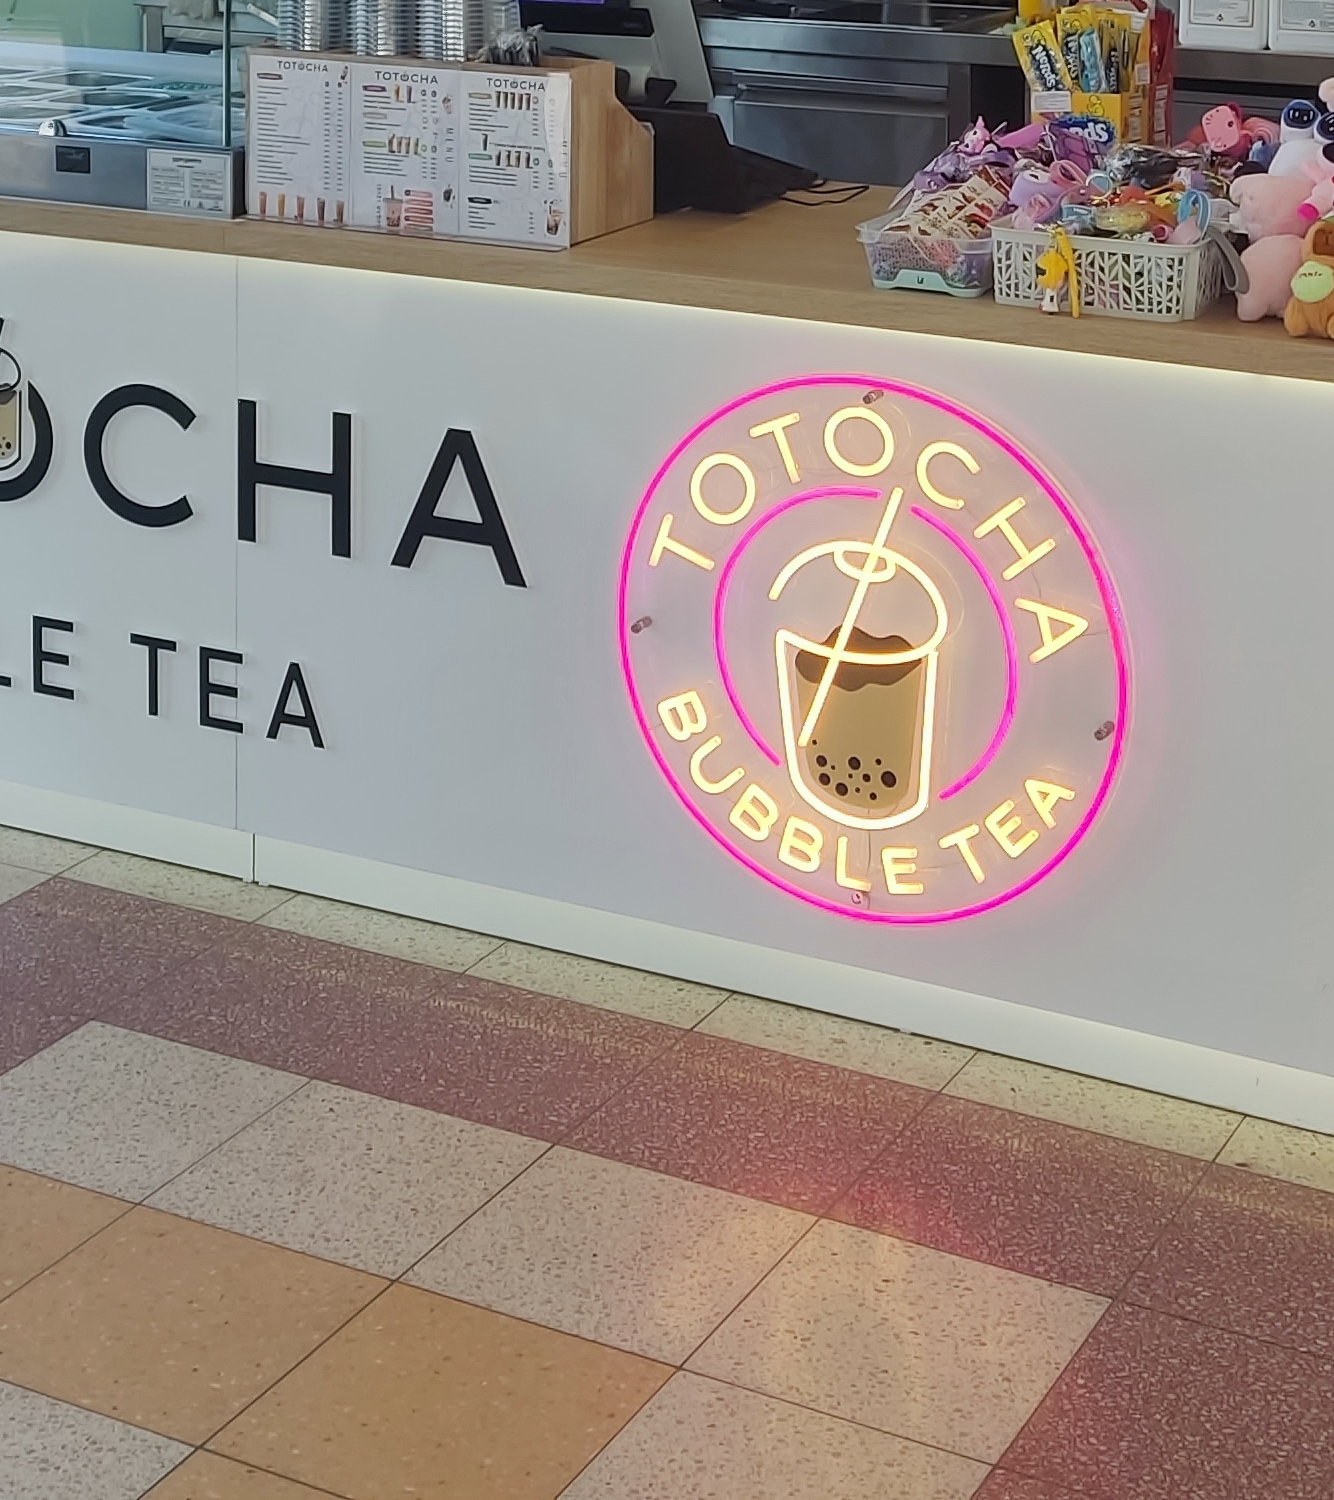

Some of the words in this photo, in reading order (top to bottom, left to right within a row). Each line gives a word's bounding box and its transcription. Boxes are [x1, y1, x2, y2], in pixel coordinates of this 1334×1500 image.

[277, 60, 329, 73] TOTOCHA
[374, 70, 439, 85] TOTOCHA
[486, 77, 546, 93] TOTOCHA
[648, 406, 1089, 663] TOTOCHA
[130, 632, 325, 749] TEA
[657, 690, 924, 896] BUBBLE
[938, 777, 1076, 884] TEA
